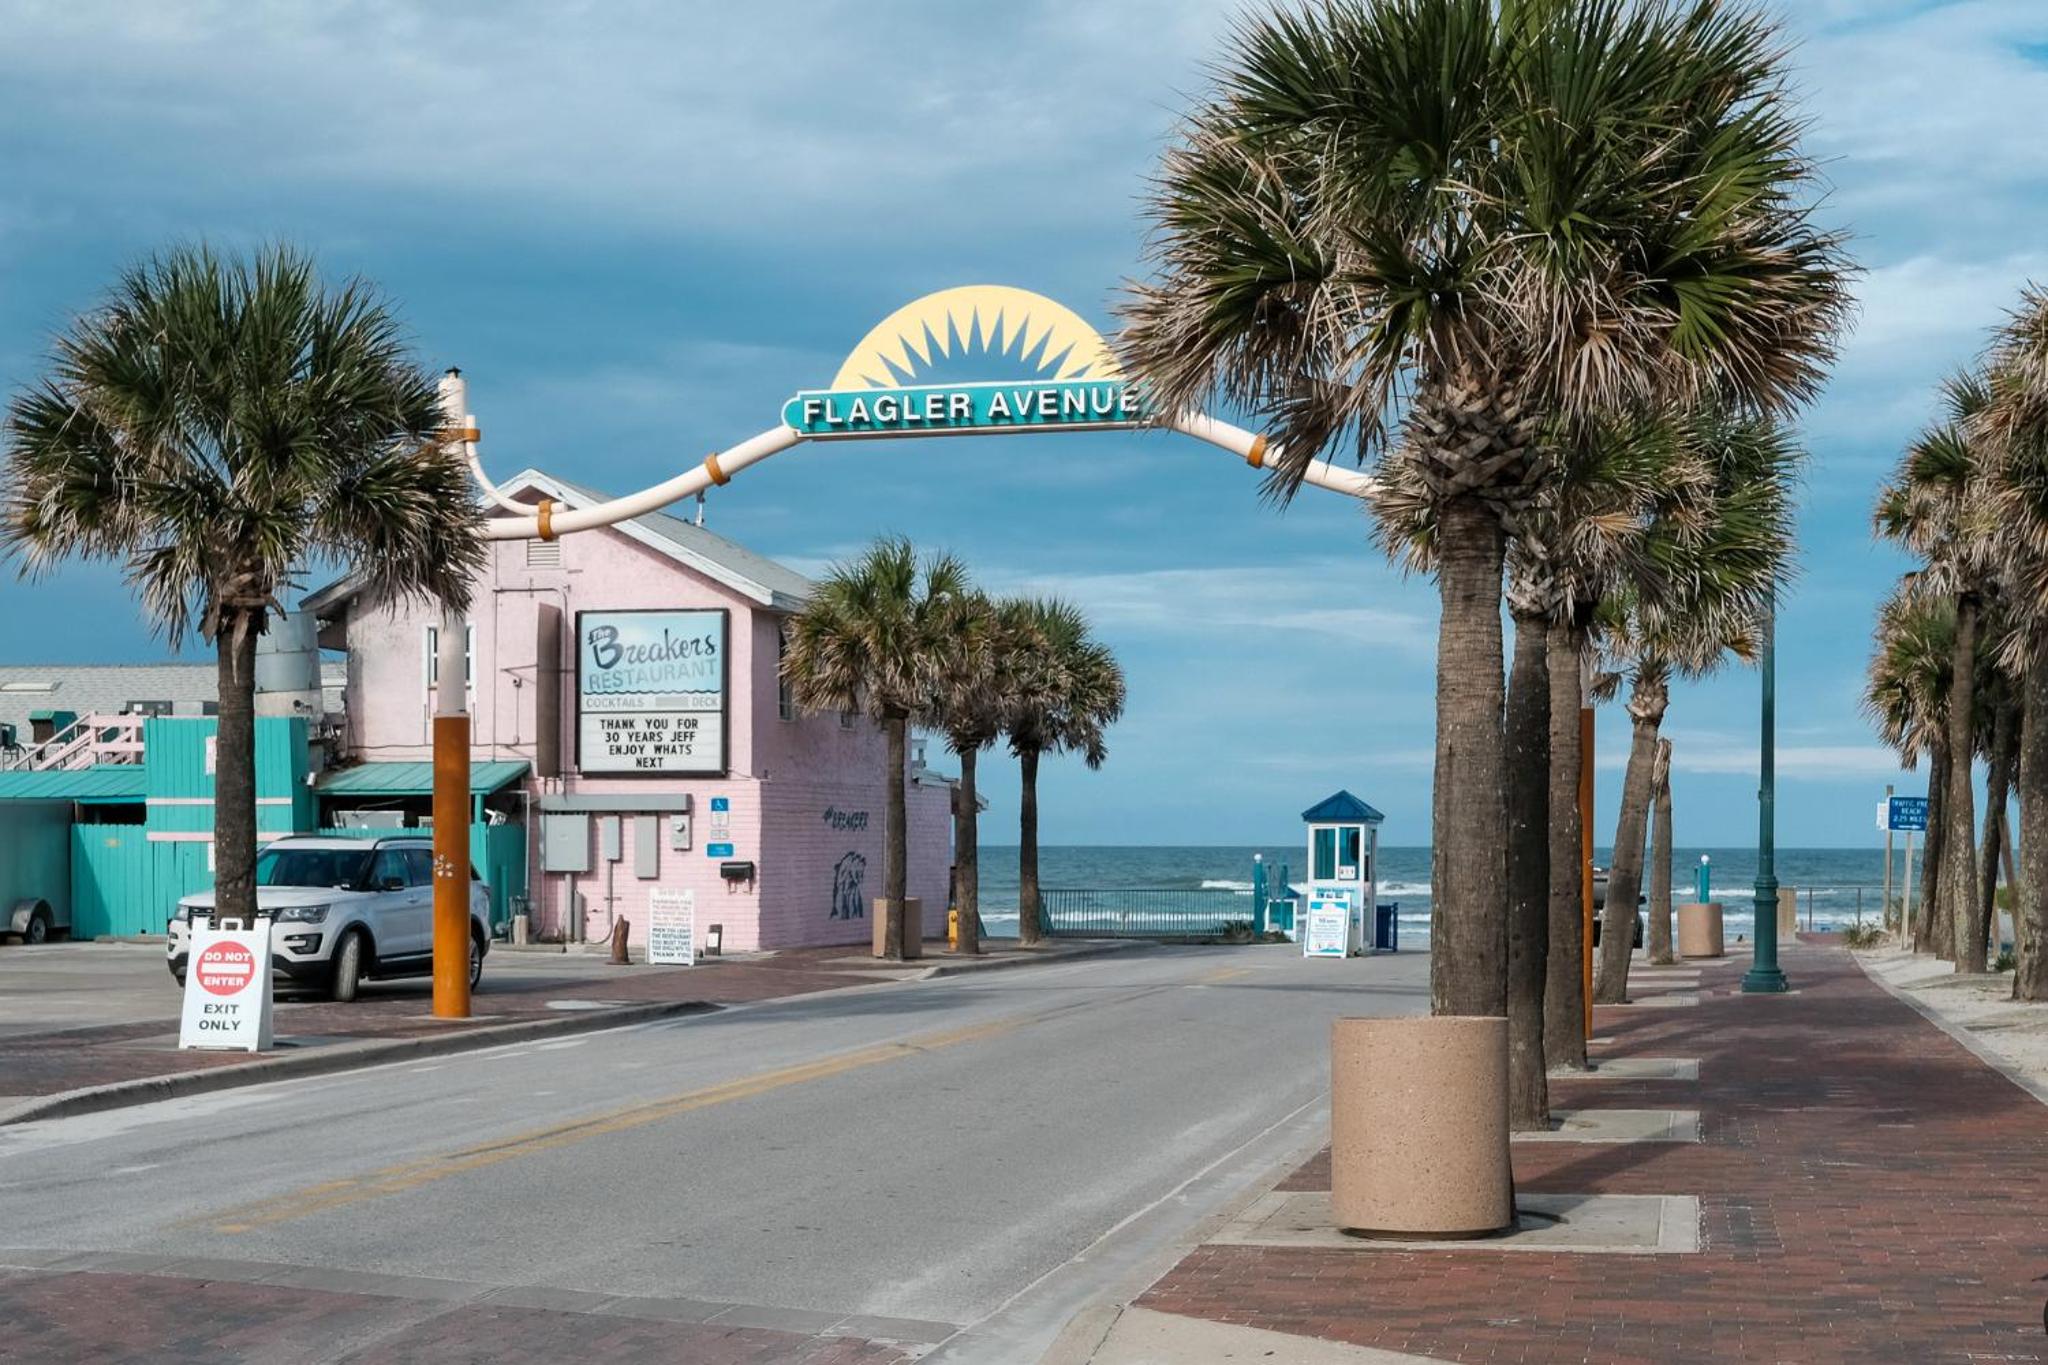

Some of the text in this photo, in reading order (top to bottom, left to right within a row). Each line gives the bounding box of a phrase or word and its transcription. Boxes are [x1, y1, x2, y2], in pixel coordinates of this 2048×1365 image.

[803, 385, 1140, 424] FLAGLER AVENUE
[588, 625, 716, 670] Breakers
[589, 658, 717, 690] RESTAURANT
[586, 696, 718, 708] COCKTAILS DECK
[600, 719, 698, 729] THANK YOU FOR
[605, 732, 695, 742] 30 YEARS JEFF
[609, 744, 692, 755] ENJOY WHATS
[636, 757, 664, 768] NEXT
[1901, 807, 1921, 815] BEACH
[205, 952, 250, 960] DO NOT
[204, 977, 244, 986] ENTER
[204, 1004, 239, 1014] EXIT
[199, 1020, 241, 1030] ONLY
